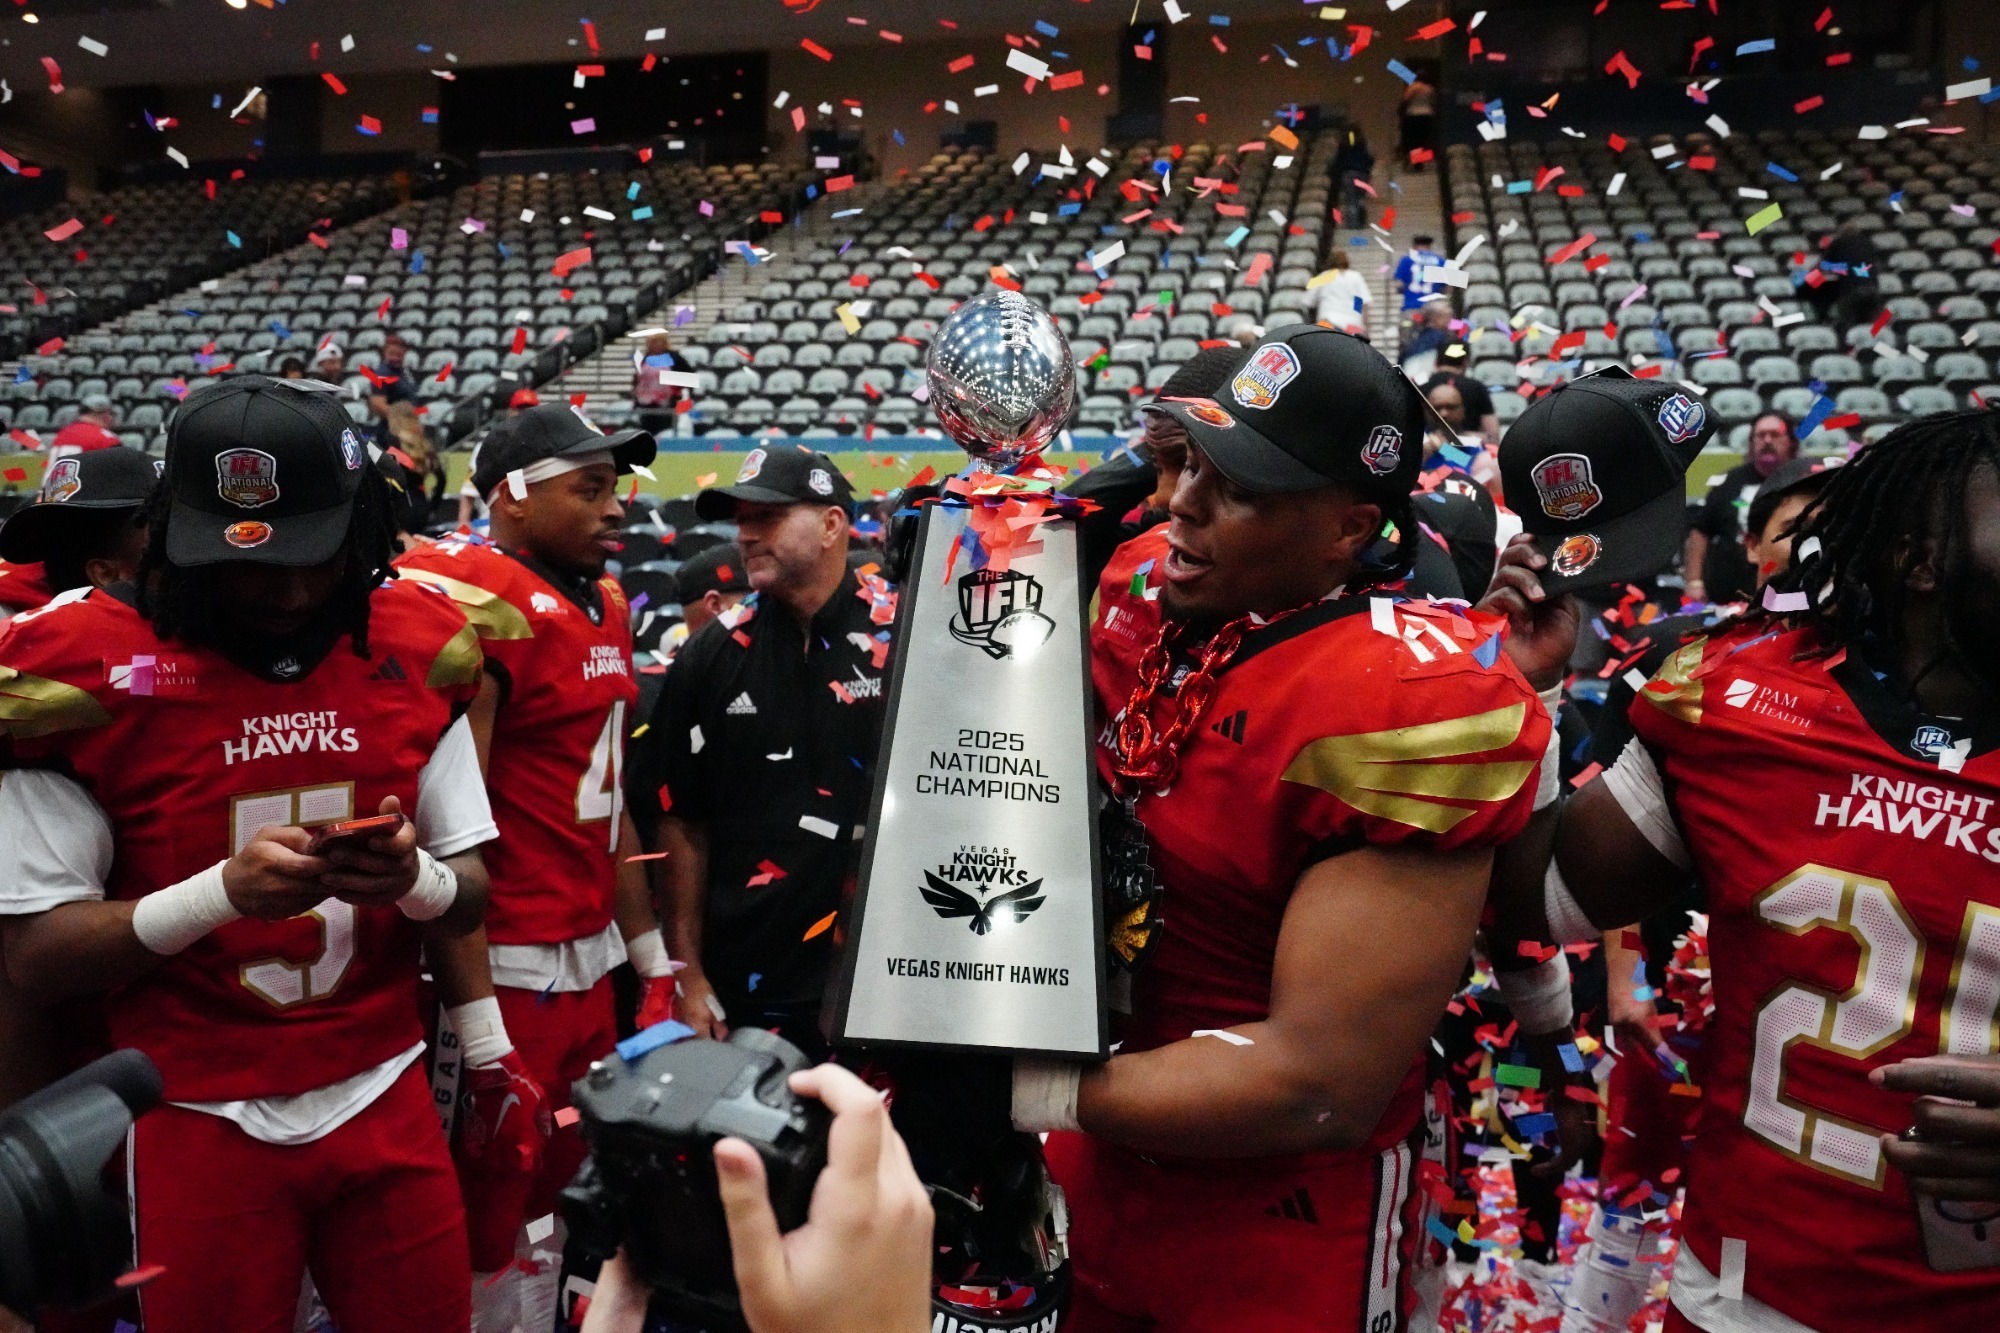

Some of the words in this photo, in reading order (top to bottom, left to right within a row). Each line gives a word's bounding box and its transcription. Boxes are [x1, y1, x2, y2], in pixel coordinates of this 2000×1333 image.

[1257, 348, 1291, 376] IFL
[1241, 365, 1279, 397] NATIONAL
[1666, 399, 1689, 431] IFL
[1371, 435, 1398, 453] IFL
[230, 455, 262, 476] IFL
[1543, 461, 1576, 487] IFL
[223, 476, 273, 490] NATIONAL
[1542, 481, 1592, 506] NATIONAL
[976, 572, 1003, 582] THE
[969, 580, 1035, 625] IFL
[1117, 610, 1134, 624] PAM
[589, 645, 620, 660] KNIGHT
[155, 676, 196, 686] EALTH
[1759, 687, 1799, 709] PAM
[726, 705, 758, 715] adidas
[1752, 700, 1811, 728] HEALTH
[242, 710, 338, 736] KNIGHT
[221, 727, 360, 766] HAWKS
[958, 729, 1024, 751] 2025
[930, 751, 1049, 778] NATIONAL
[916, 774, 1060, 803] CHAMPIONS
[1850, 773, 1995, 821] KNIGHT
[953, 852, 1017, 868] KNIGHT
[960, 844, 1010, 854] VEGAS
[938, 865, 1028, 886] HAWKS
[887, 957, 940, 979] VEGAS
[945, 961, 1005, 982] KNIGHT
[1010, 965, 1069, 987] HAWKS
